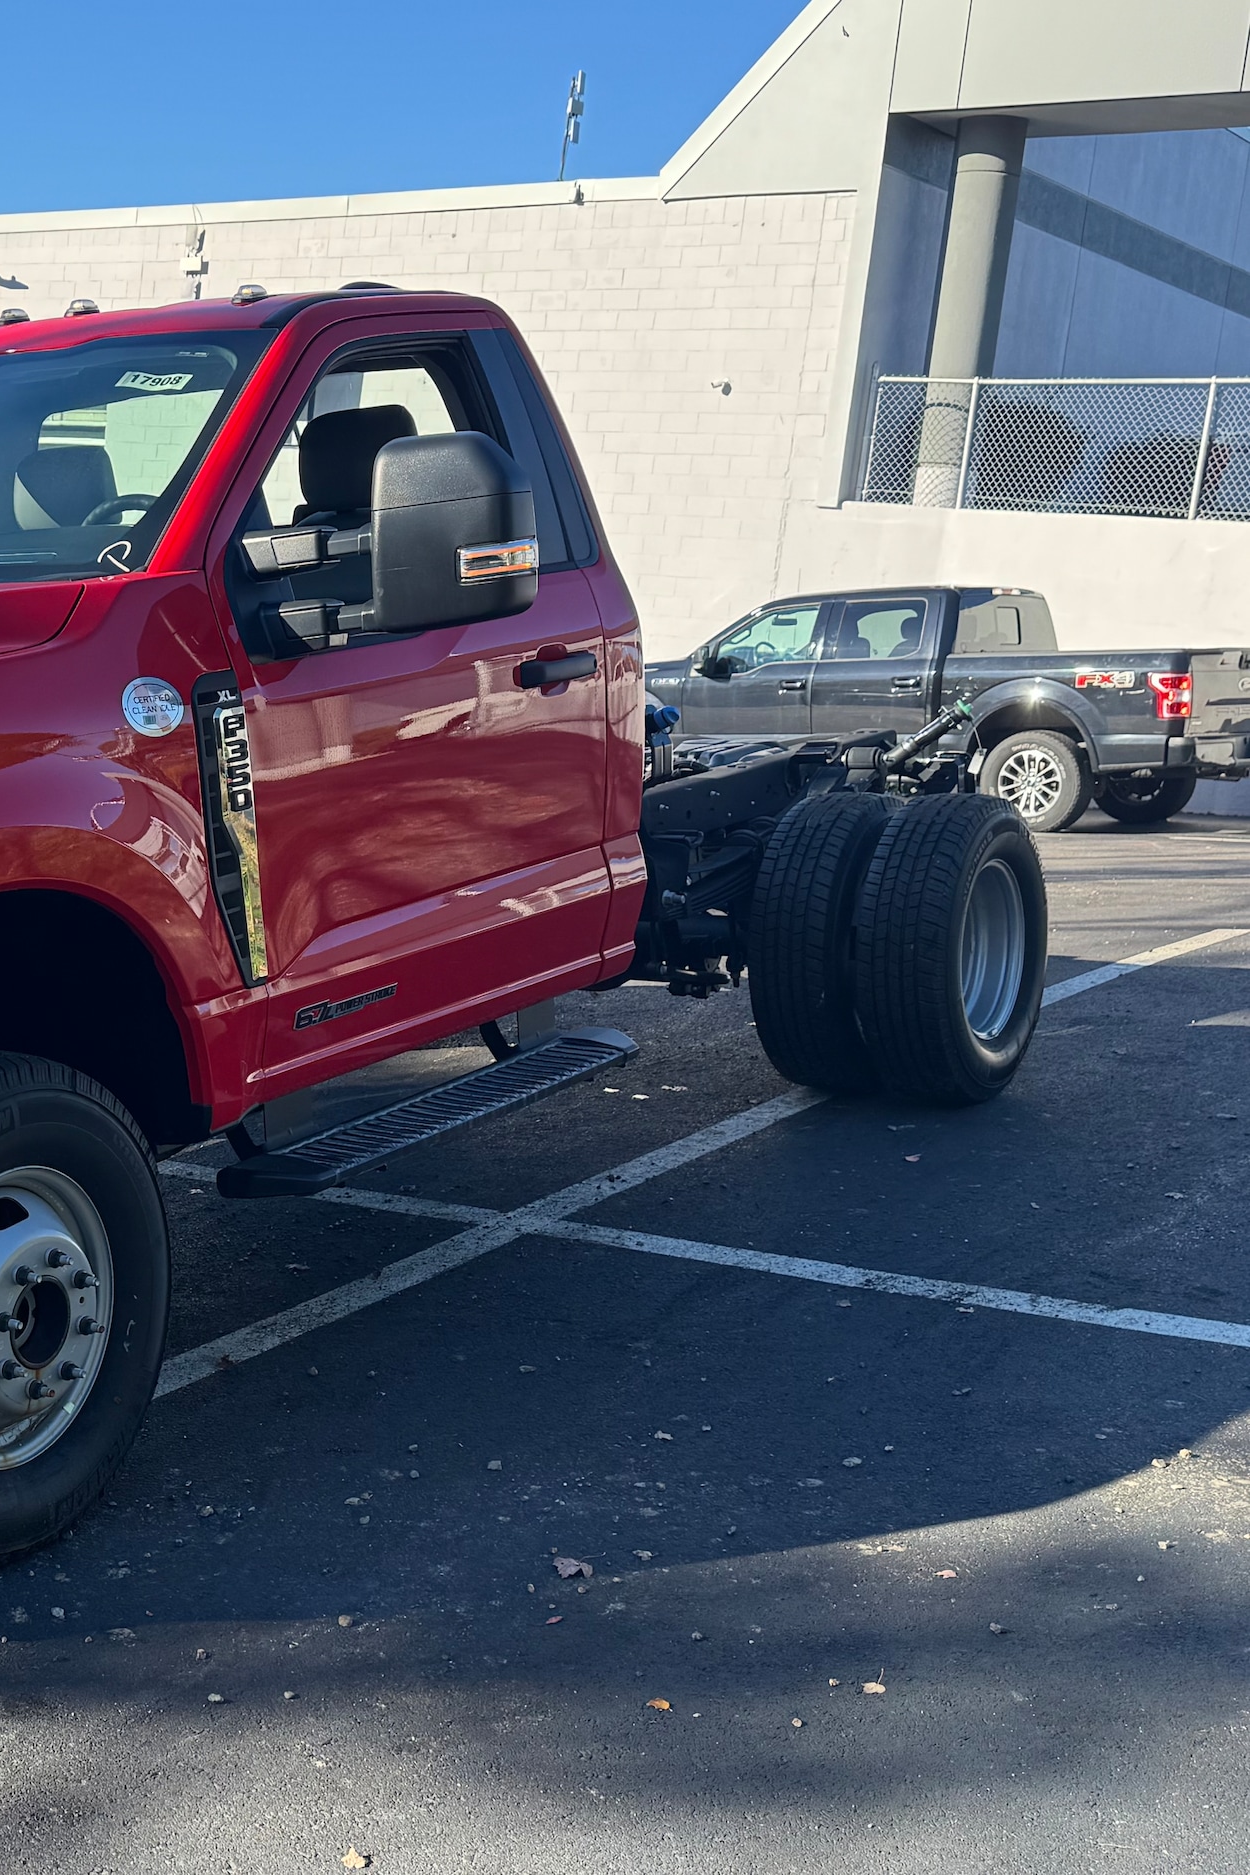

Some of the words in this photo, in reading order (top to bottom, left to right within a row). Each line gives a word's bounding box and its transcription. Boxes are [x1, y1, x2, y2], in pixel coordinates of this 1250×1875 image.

[129, 373, 183, 387] 17908
[1075, 671, 1135, 689] FX4
[133, 693, 171, 705] CERTIFIED
[217, 690, 237, 702] XL
[132, 705, 157, 715] CLEAN
[223, 713, 253, 812] F350
